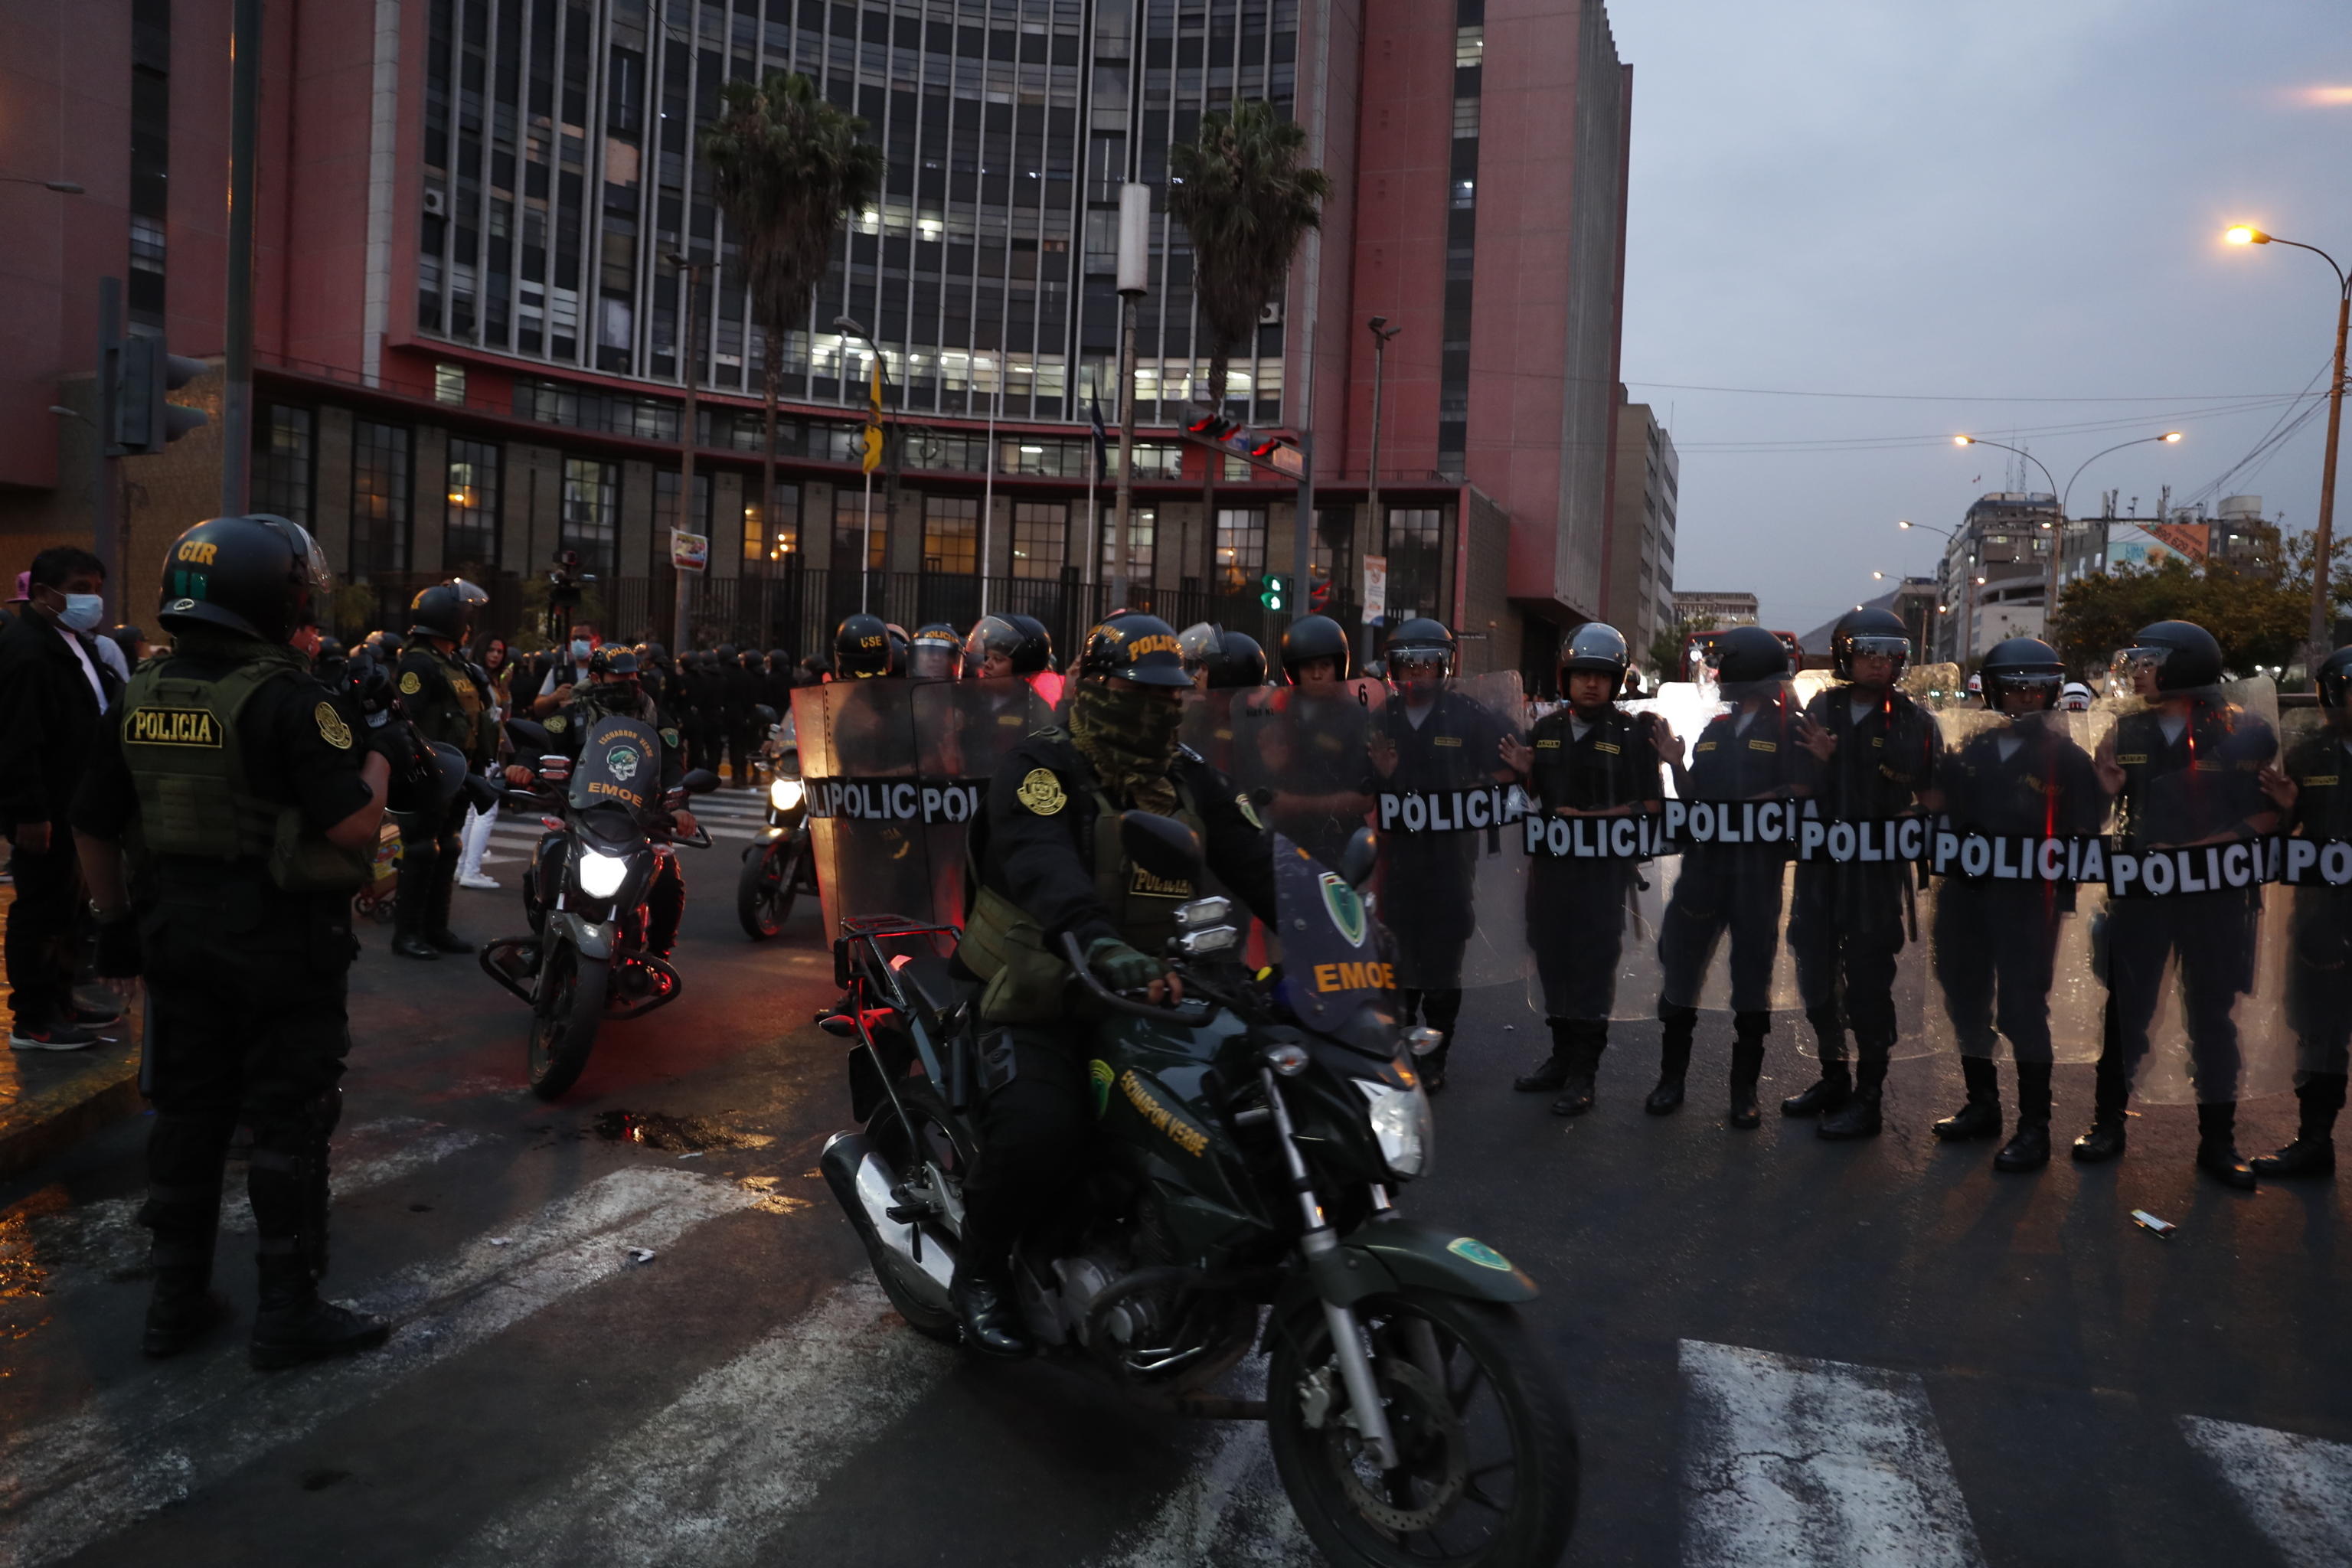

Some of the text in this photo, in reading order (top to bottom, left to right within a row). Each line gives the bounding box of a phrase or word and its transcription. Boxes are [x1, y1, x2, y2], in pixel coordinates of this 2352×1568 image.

[178, 541, 218, 565] GIR
[860, 635, 882, 648] USE
[1358, 684, 1368, 706] 6
[134, 711, 214, 743] POLICIA
[588, 782, 643, 808] EMOE
[1380, 785, 1523, 831] POLICIA
[1935, 832, 2105, 881] POLICIA
[2110, 836, 2281, 896] POLICIA
[1313, 962, 1397, 992] EMOE
